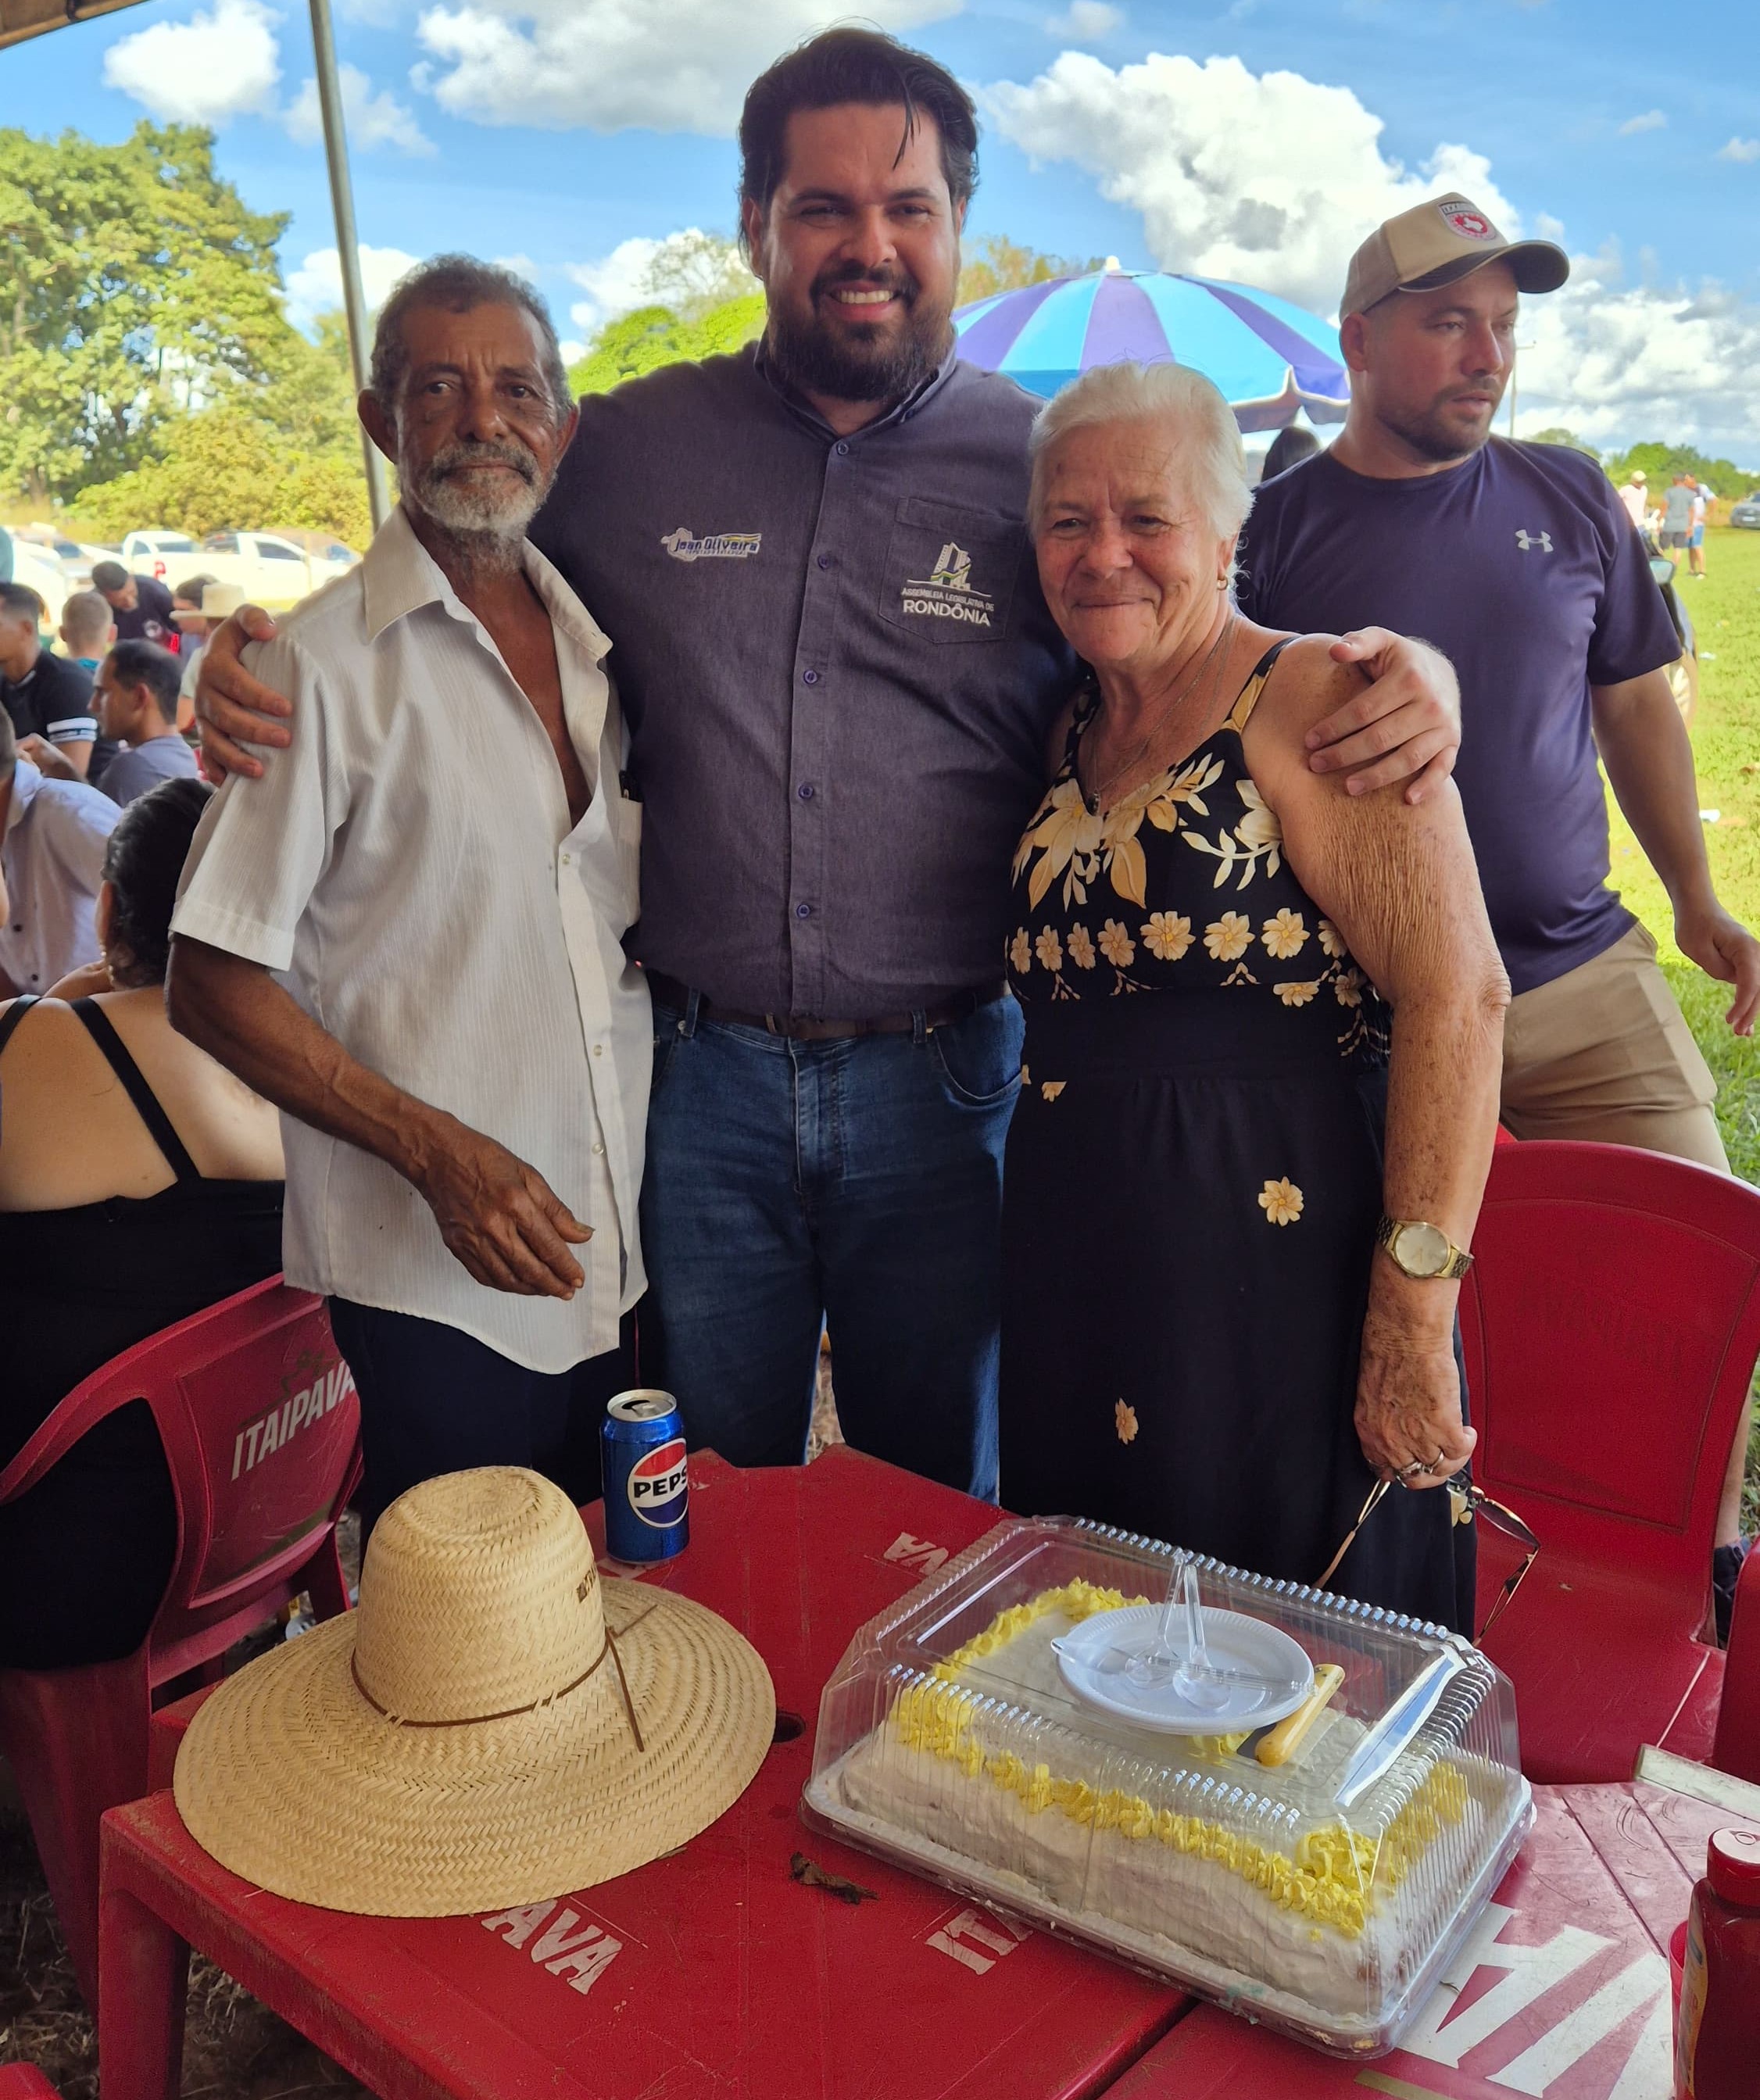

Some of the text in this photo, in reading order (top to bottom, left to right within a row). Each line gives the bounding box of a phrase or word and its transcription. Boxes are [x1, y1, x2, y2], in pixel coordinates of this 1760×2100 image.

[901, 588, 995, 612] ASSEMBLEIA LEGISLATIVA DE
[903, 599, 991, 627] RONDÔNIA
